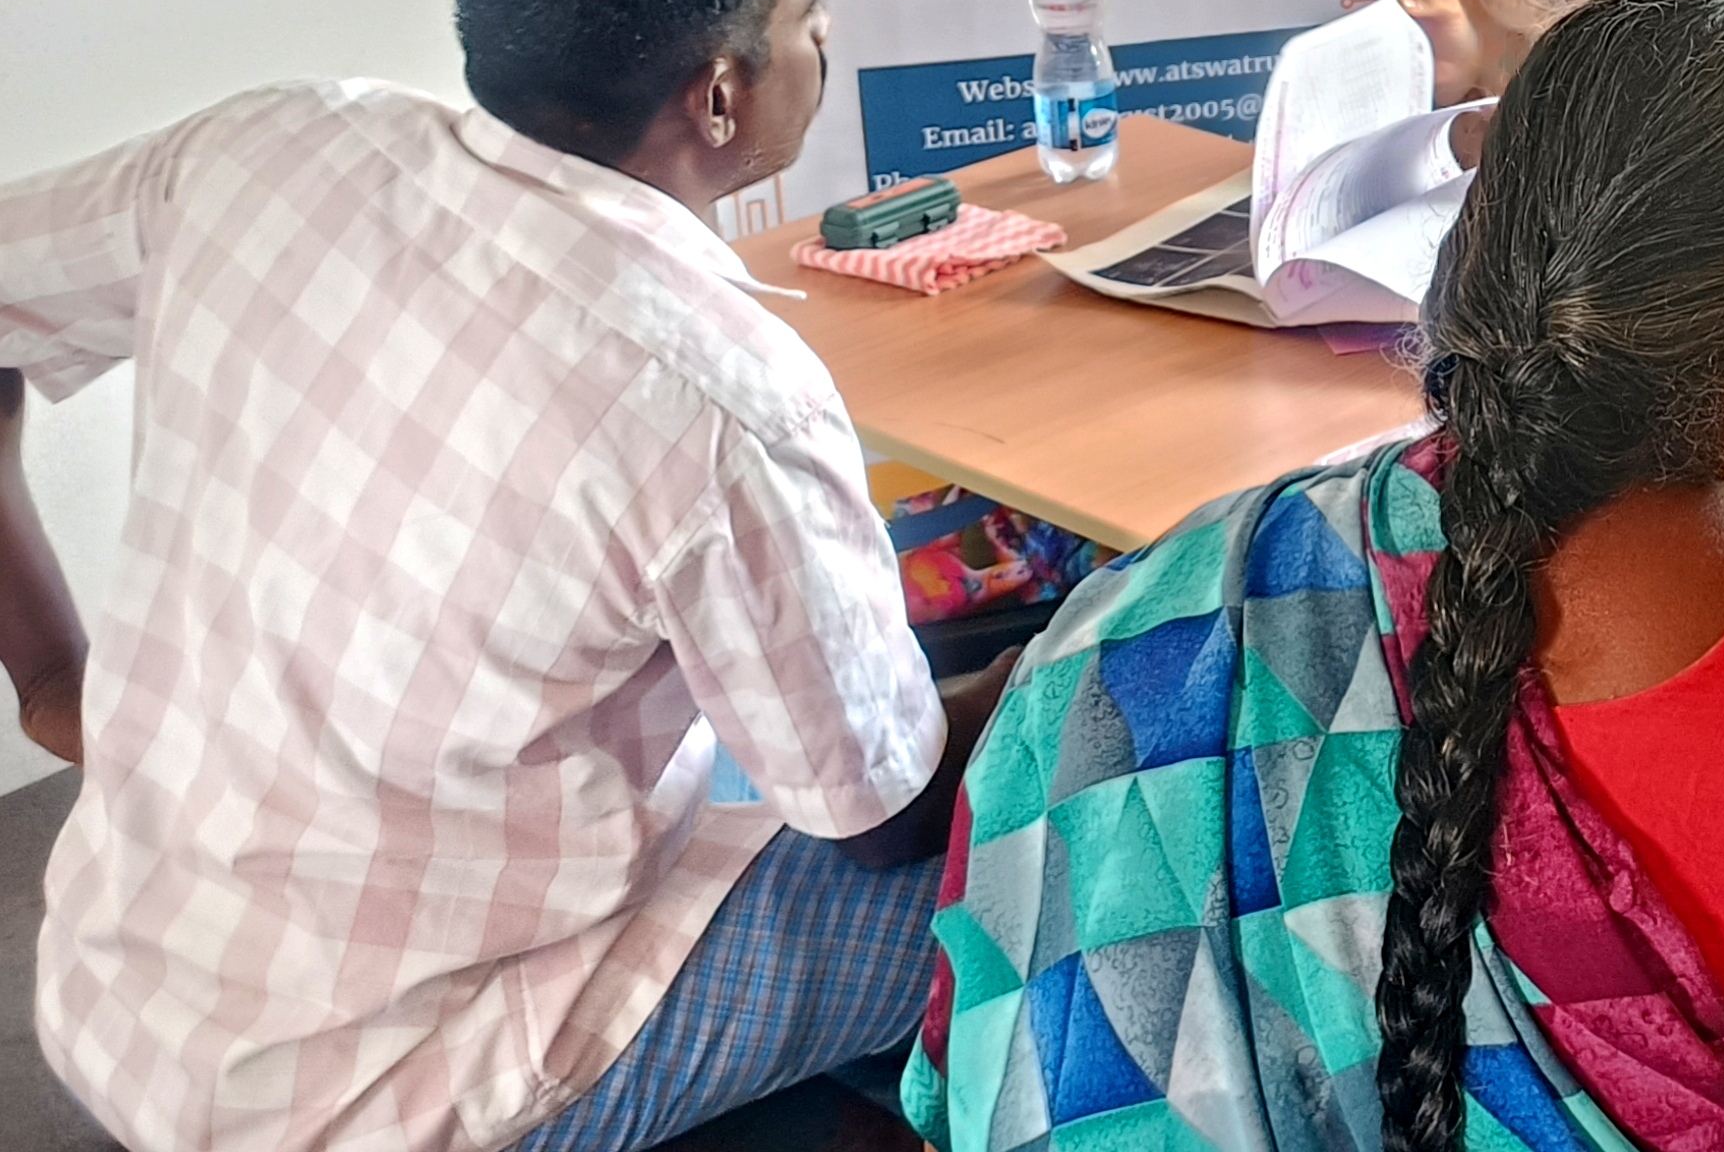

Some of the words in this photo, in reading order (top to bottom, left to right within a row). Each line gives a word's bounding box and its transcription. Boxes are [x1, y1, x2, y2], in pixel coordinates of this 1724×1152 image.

[957, 76, 1035, 104] Webs
[1114, 55, 1279, 88] ww.atswatru
[922, 120, 1016, 150] Email:
